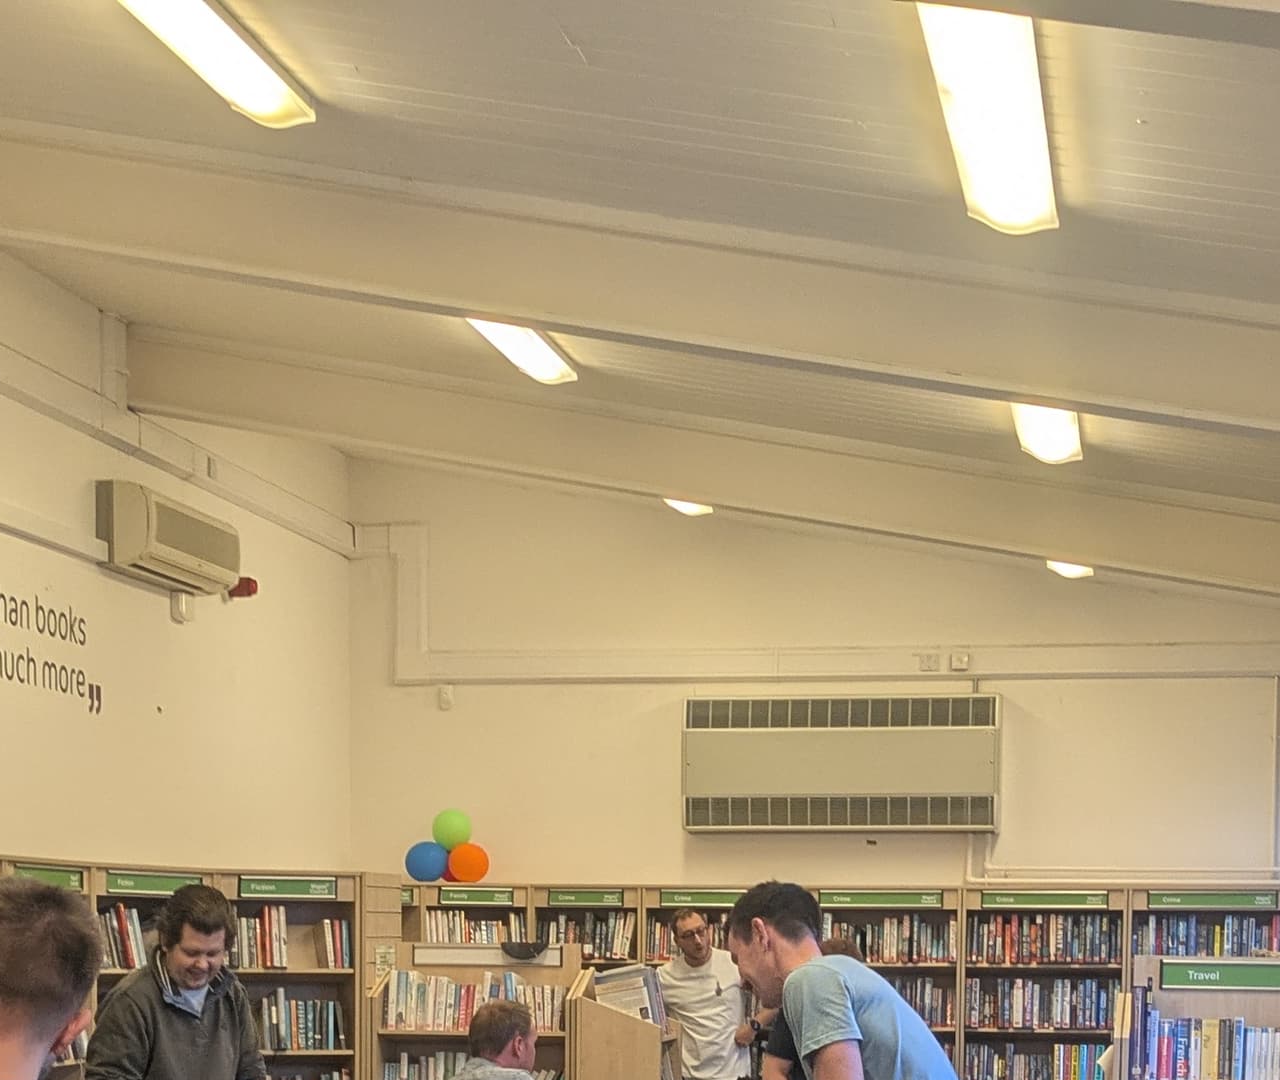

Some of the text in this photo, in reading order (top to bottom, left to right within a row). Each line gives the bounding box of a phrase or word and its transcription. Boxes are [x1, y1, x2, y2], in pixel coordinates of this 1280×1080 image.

[35, 594, 86, 646] books
[251, 883, 276, 892] Fiction
[1187, 970, 1220, 981] Travel
[1177, 1037, 1189, 1078] French
